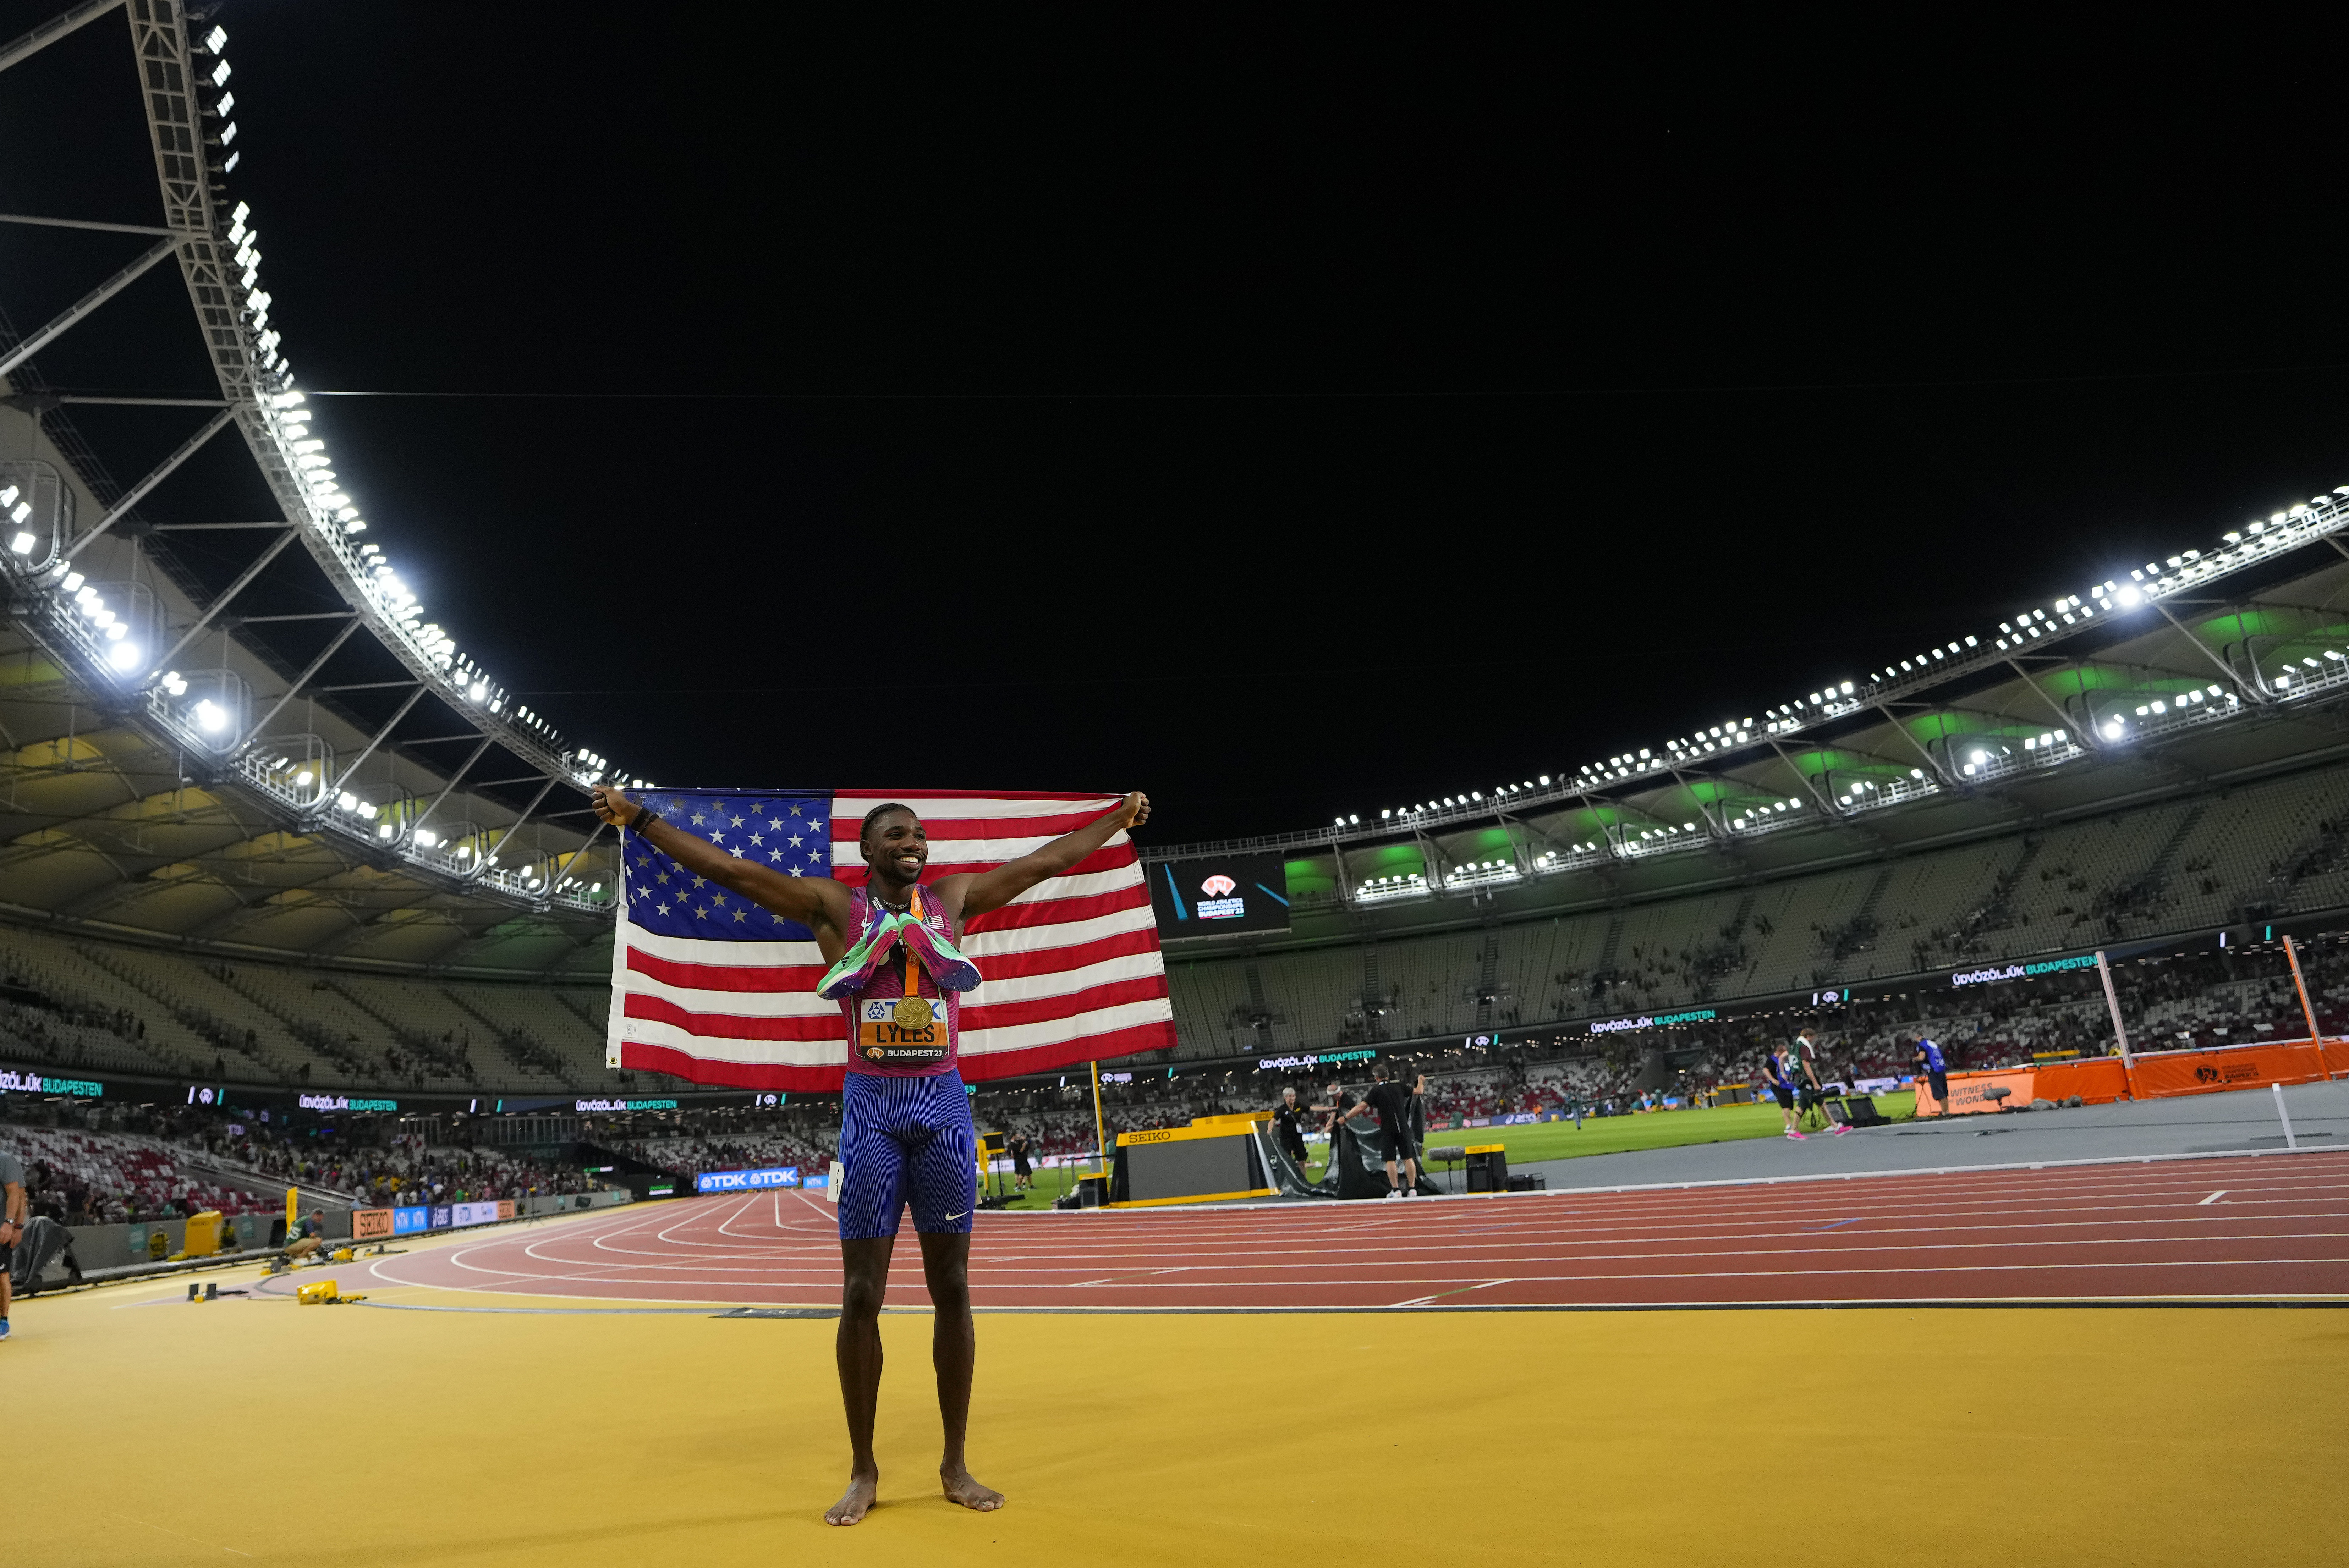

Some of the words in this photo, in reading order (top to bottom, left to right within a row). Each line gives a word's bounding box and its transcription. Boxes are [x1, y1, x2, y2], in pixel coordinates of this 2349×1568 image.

[1197, 903, 1244, 912] CHAMPIONSHIPS
[1198, 908, 1235, 917] BUDAPEST
[2026, 955, 2098, 975] BUDAPESTEN
[885, 1002, 941, 1019] TK
[1654, 1009, 1716, 1025] BUDAPESTEN
[876, 1024, 935, 1043] LYLES
[1319, 1050, 1376, 1063] BUDAPESTEN
[43, 1078, 103, 1096] BUDAPESTEN
[1950, 1083, 1993, 1097] WITNESS
[349, 1099, 397, 1111] BUDAPESTEN
[627, 1100, 677, 1110] BUDAPESTEN
[1956, 1093, 1985, 1105] WOND
[1129, 1132, 1170, 1143] SEIKO
[711, 1174, 747, 1188] TDK
[760, 1170, 795, 1184] TDK
[807, 1178, 822, 1187] NTN
[360, 1211, 388, 1237] SEIKO
